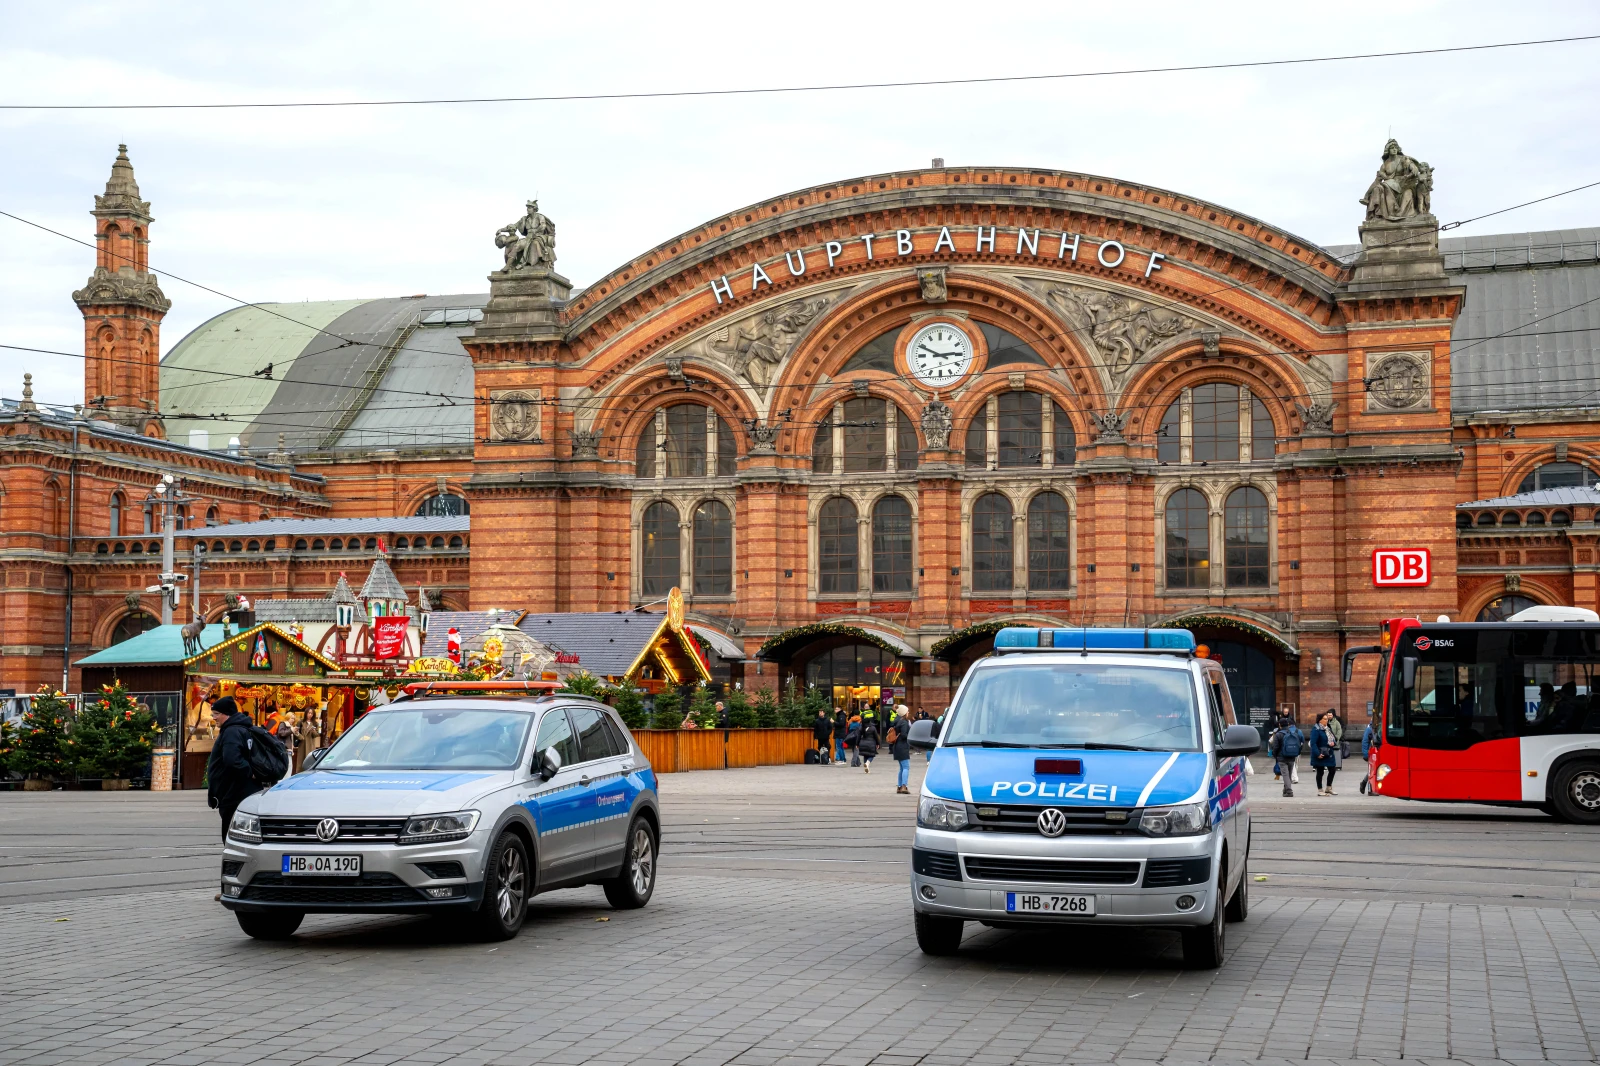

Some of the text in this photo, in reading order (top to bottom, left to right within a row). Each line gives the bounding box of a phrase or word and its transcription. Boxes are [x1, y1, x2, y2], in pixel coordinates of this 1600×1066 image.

[710, 226, 1166, 304] HAUPTBAHNHOF
[1380, 554, 1424, 581] DB
[1434, 639, 1454, 647] BSAG
[991, 781, 1118, 802] POLIZEI
[290, 857, 359, 871] HB OA 190
[1022, 895, 1087, 911] HB 7268
